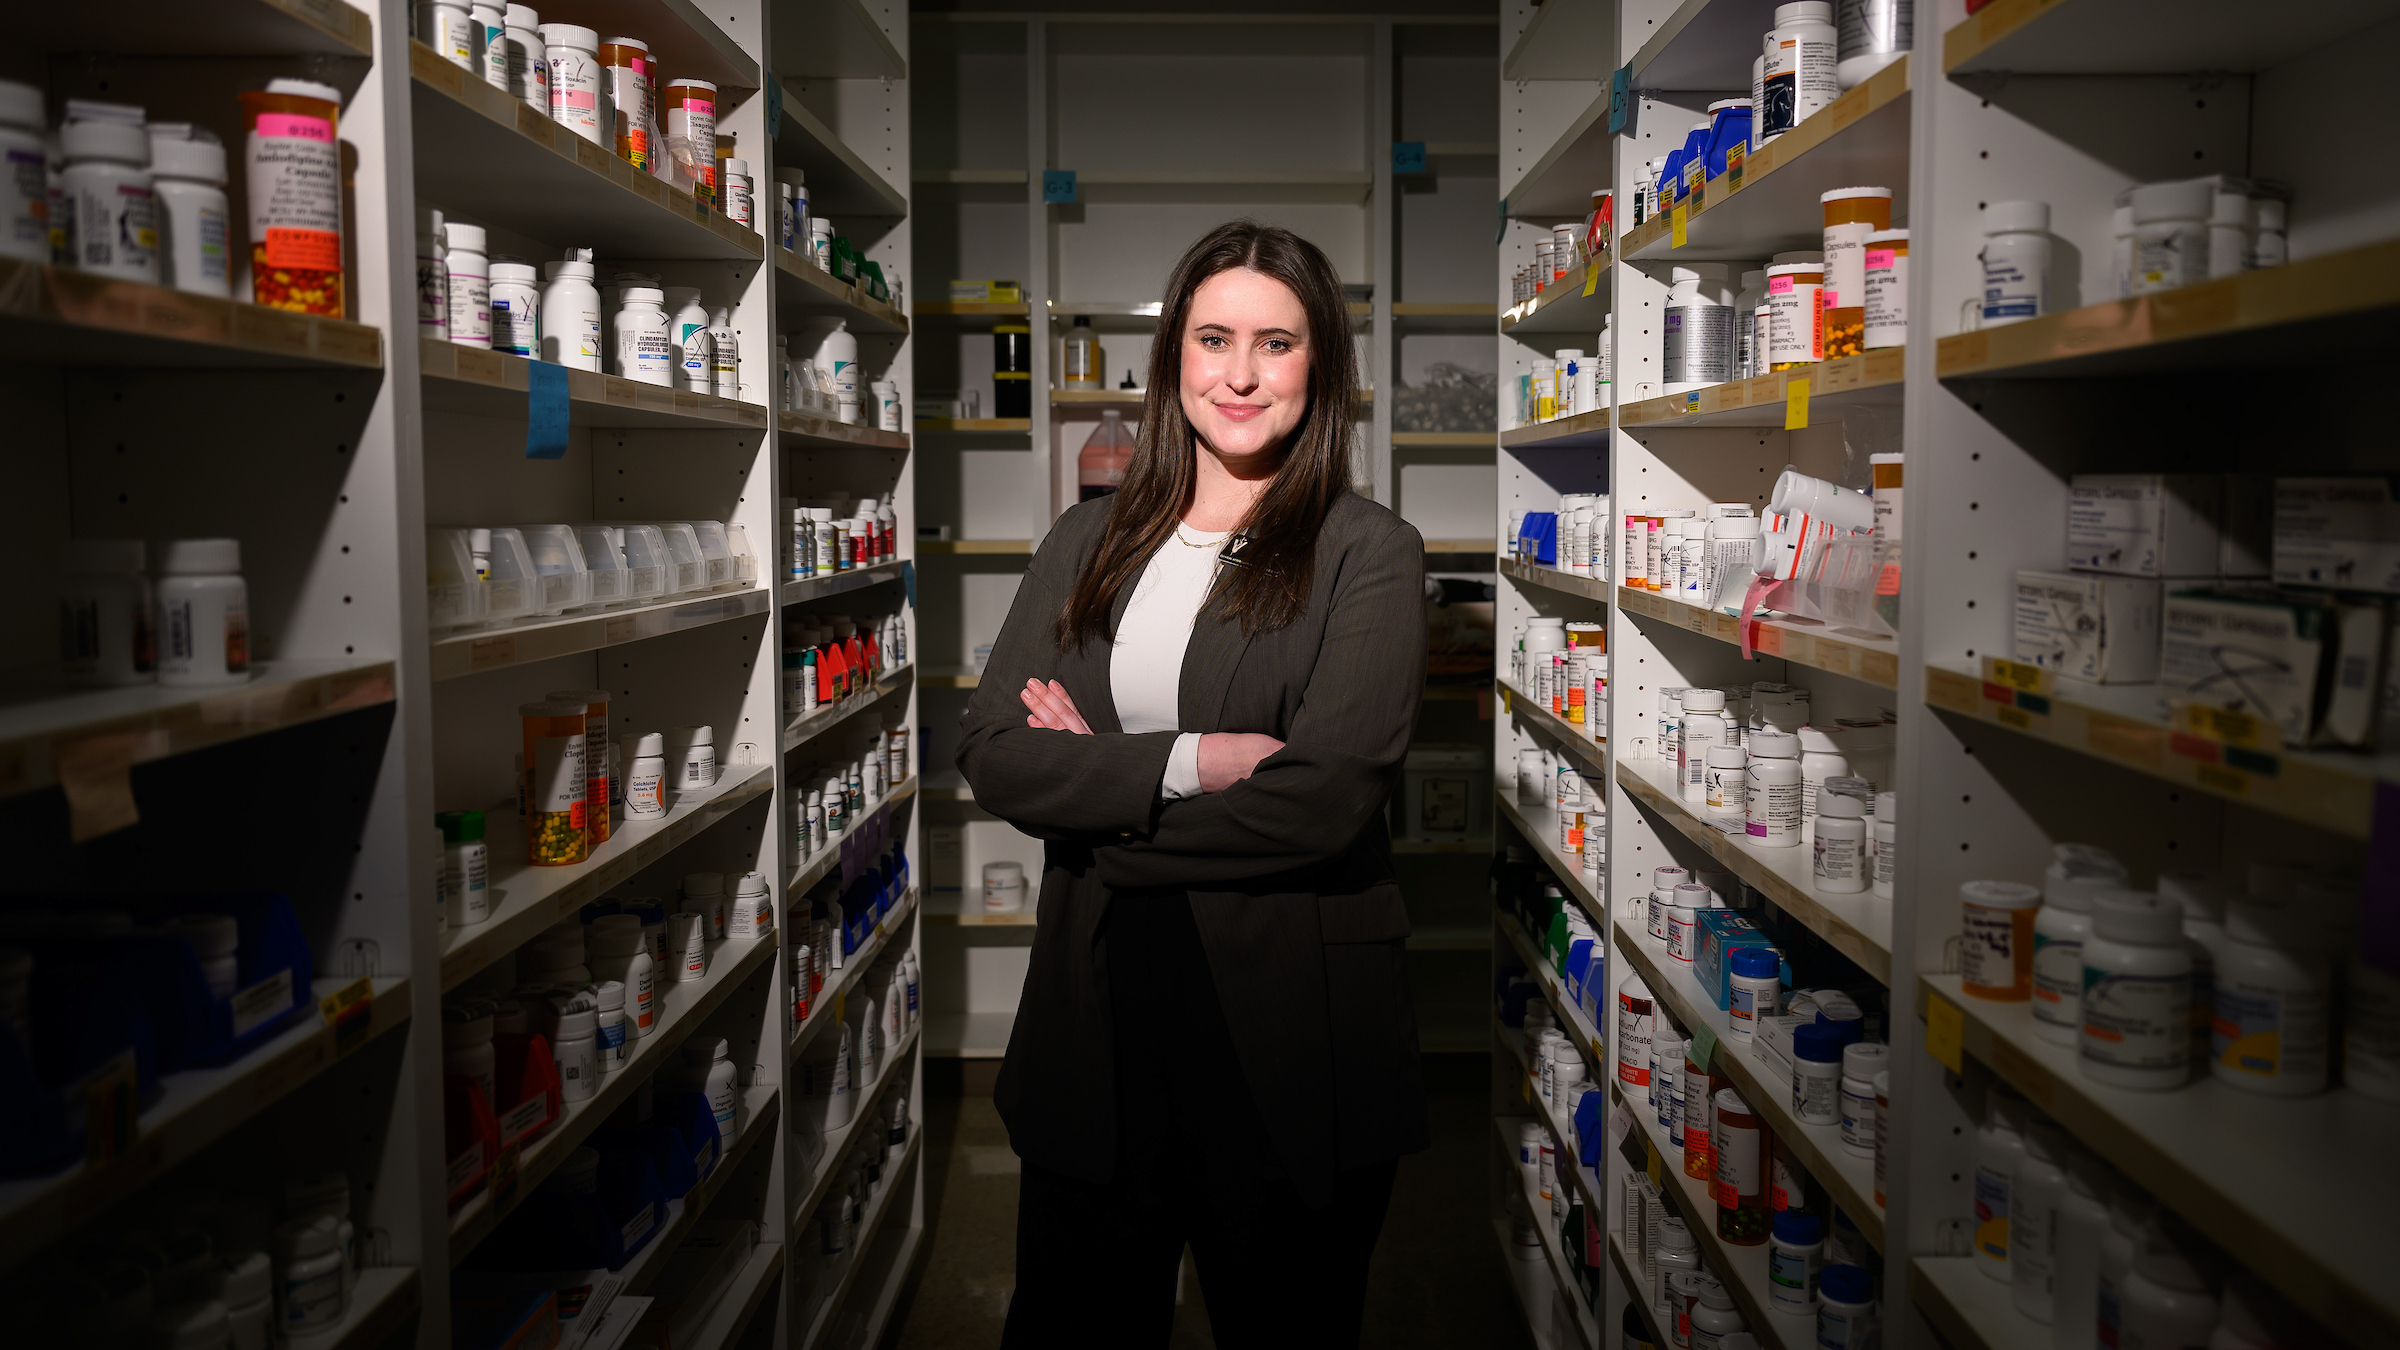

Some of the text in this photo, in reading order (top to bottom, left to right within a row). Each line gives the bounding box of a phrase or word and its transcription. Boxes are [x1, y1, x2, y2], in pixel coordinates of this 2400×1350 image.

[1395, 152, 1422, 165] G-4
[1047, 180, 1073, 194] G-3
[1670, 316, 1681, 325] mg
